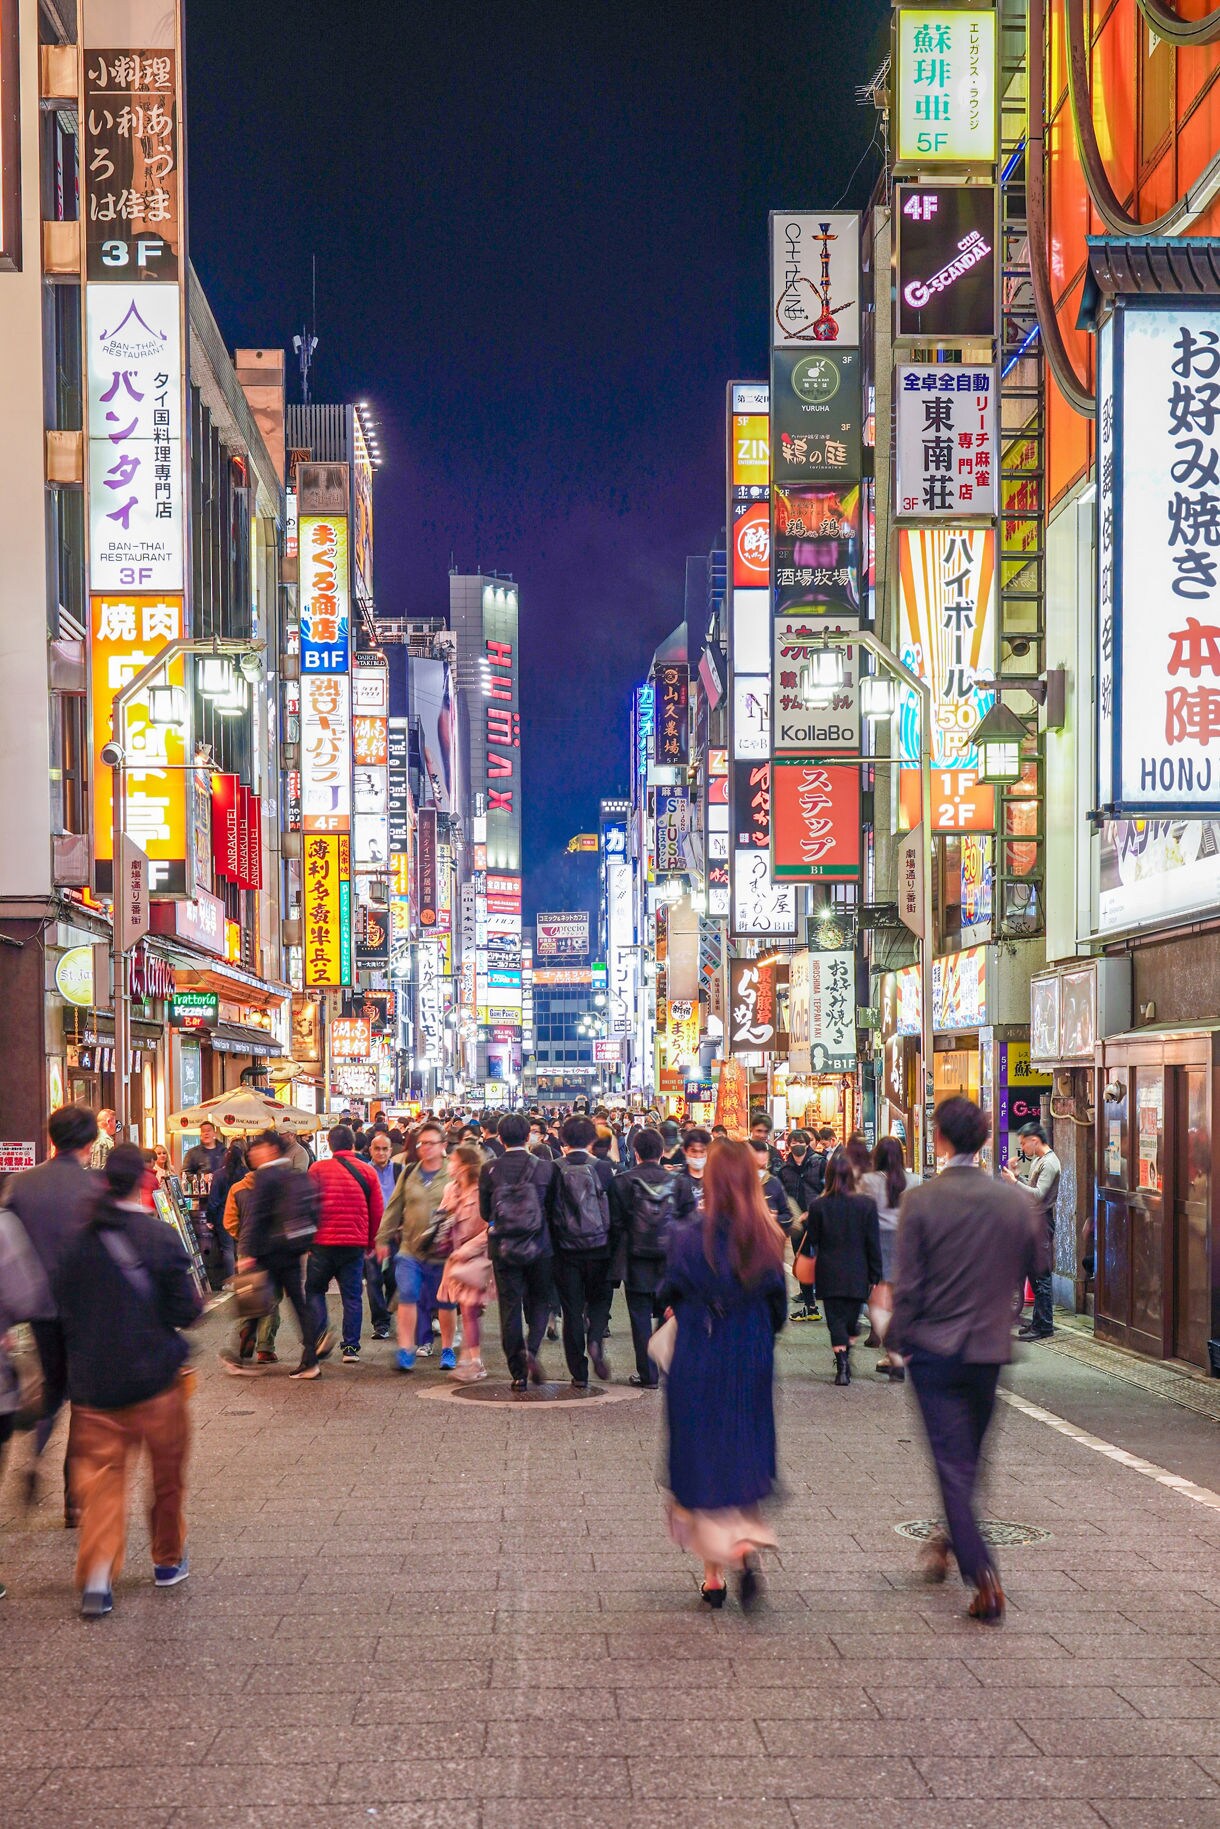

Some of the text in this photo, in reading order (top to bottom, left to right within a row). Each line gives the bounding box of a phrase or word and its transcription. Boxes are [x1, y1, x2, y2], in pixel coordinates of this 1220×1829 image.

[88, 54, 172, 89] 小料理
[969, 24, 979, 131] エレガンス・ラウンジ
[916, 132, 949, 152] 5F
[903, 195, 938, 220] 4F
[101, 240, 164, 267] 3F
[957, 230, 981, 251] CLUB
[904, 241, 992, 308] G-SCANDAL
[102, 344, 166, 360] RESTAURANT
[109, 340, 158, 350] BAN-THAI
[903, 372, 990, 392] 全卓全自動
[737, 417, 748, 426] 5F
[99, 369, 145, 530] バンタイ
[153, 372, 173, 519] タイ国料理専門店
[922, 396, 955, 511] 東南荘
[975, 396, 990, 488] リーチ麻雀
[958, 432, 973, 500] 専門店
[1167, 326, 1220, 599] お好み焼き
[736, 506, 747, 515] 4F
[903, 497, 918, 511] 3F
[101, 553, 172, 562] RESTAURANT
[108, 542, 165, 551] BAN-THAI
[119, 567, 153, 585] 3F
[310, 523, 338, 643] まぐろ商店
[777, 568, 850, 586] 酒場牧場
[97, 603, 179, 641] 焼肉
[943, 536, 975, 699] ハイボール
[305, 651, 344, 668] B1F
[1165, 617, 1220, 746] 本陣
[780, 694, 854, 711] サムサル
[781, 724, 854, 742] KollaBo
[940, 773, 975, 795] 1F
[1141, 757, 1220, 792] HONJ
[661, 787, 683, 796] 麻雀
[314, 816, 338, 829] 4F
[797, 769, 836, 863] ステップ
[938, 804, 976, 826] 2F
[226, 808, 236, 872] ANRAKUTEI
[239, 818, 247, 880] ANRAKUTEI
[250, 827, 258, 886] ANRAKUTEI
[811, 866, 824, 875] B1
[905, 849, 916, 914] 劇場通り一番街
[130, 859, 142, 925] 劇場通り一番街
[749, 855, 771, 932] うまいもん
[172, 993, 216, 1005] Trattoria
[813, 960, 822, 1038] HIROSHIMA TEPPANYAKI
[825, 959, 852, 1045] お好み焼き
[833, 1059, 856, 1069] B1F
